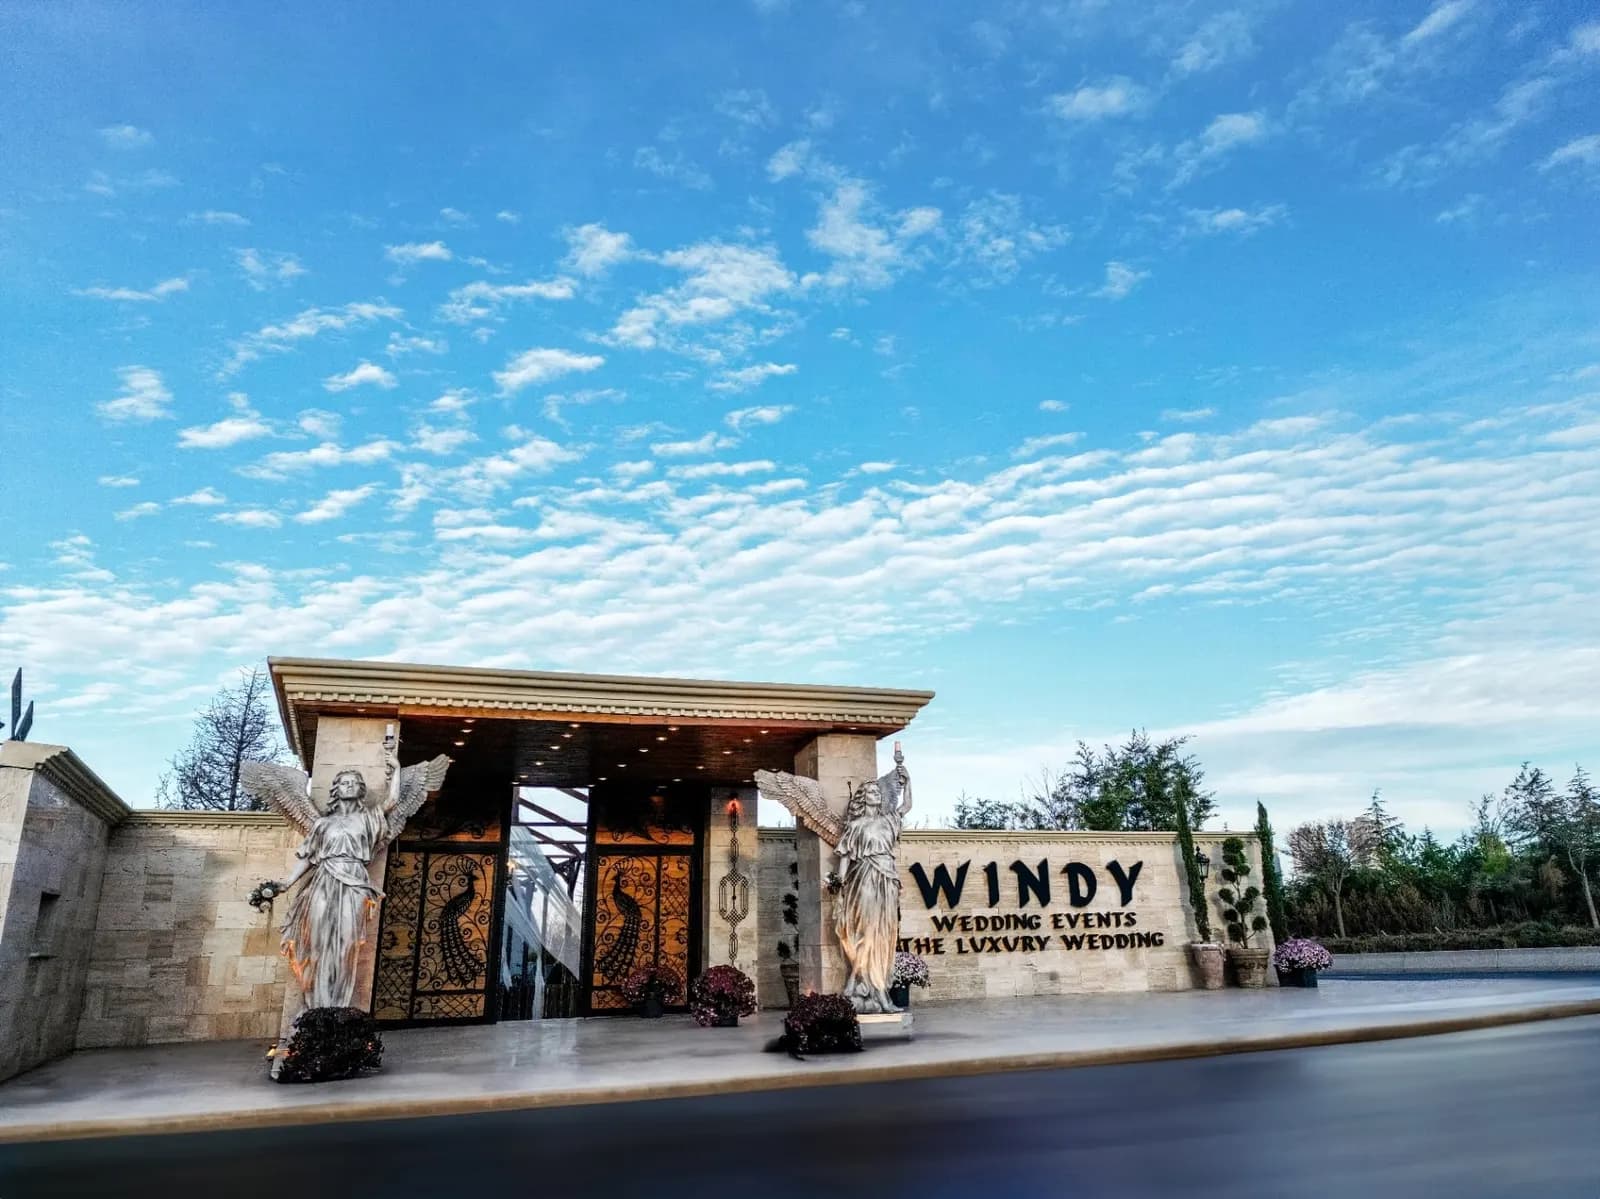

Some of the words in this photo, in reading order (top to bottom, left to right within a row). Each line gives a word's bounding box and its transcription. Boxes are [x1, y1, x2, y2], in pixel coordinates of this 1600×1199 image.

[908, 857, 1144, 909] WINDY
[930, 912, 1042, 932] WEDDING
[1052, 911, 1137, 929] EVENTS
[899, 936, 946, 956] THE
[955, 934, 1052, 955] LUXURY
[1059, 931, 1164, 951] WEDDING
